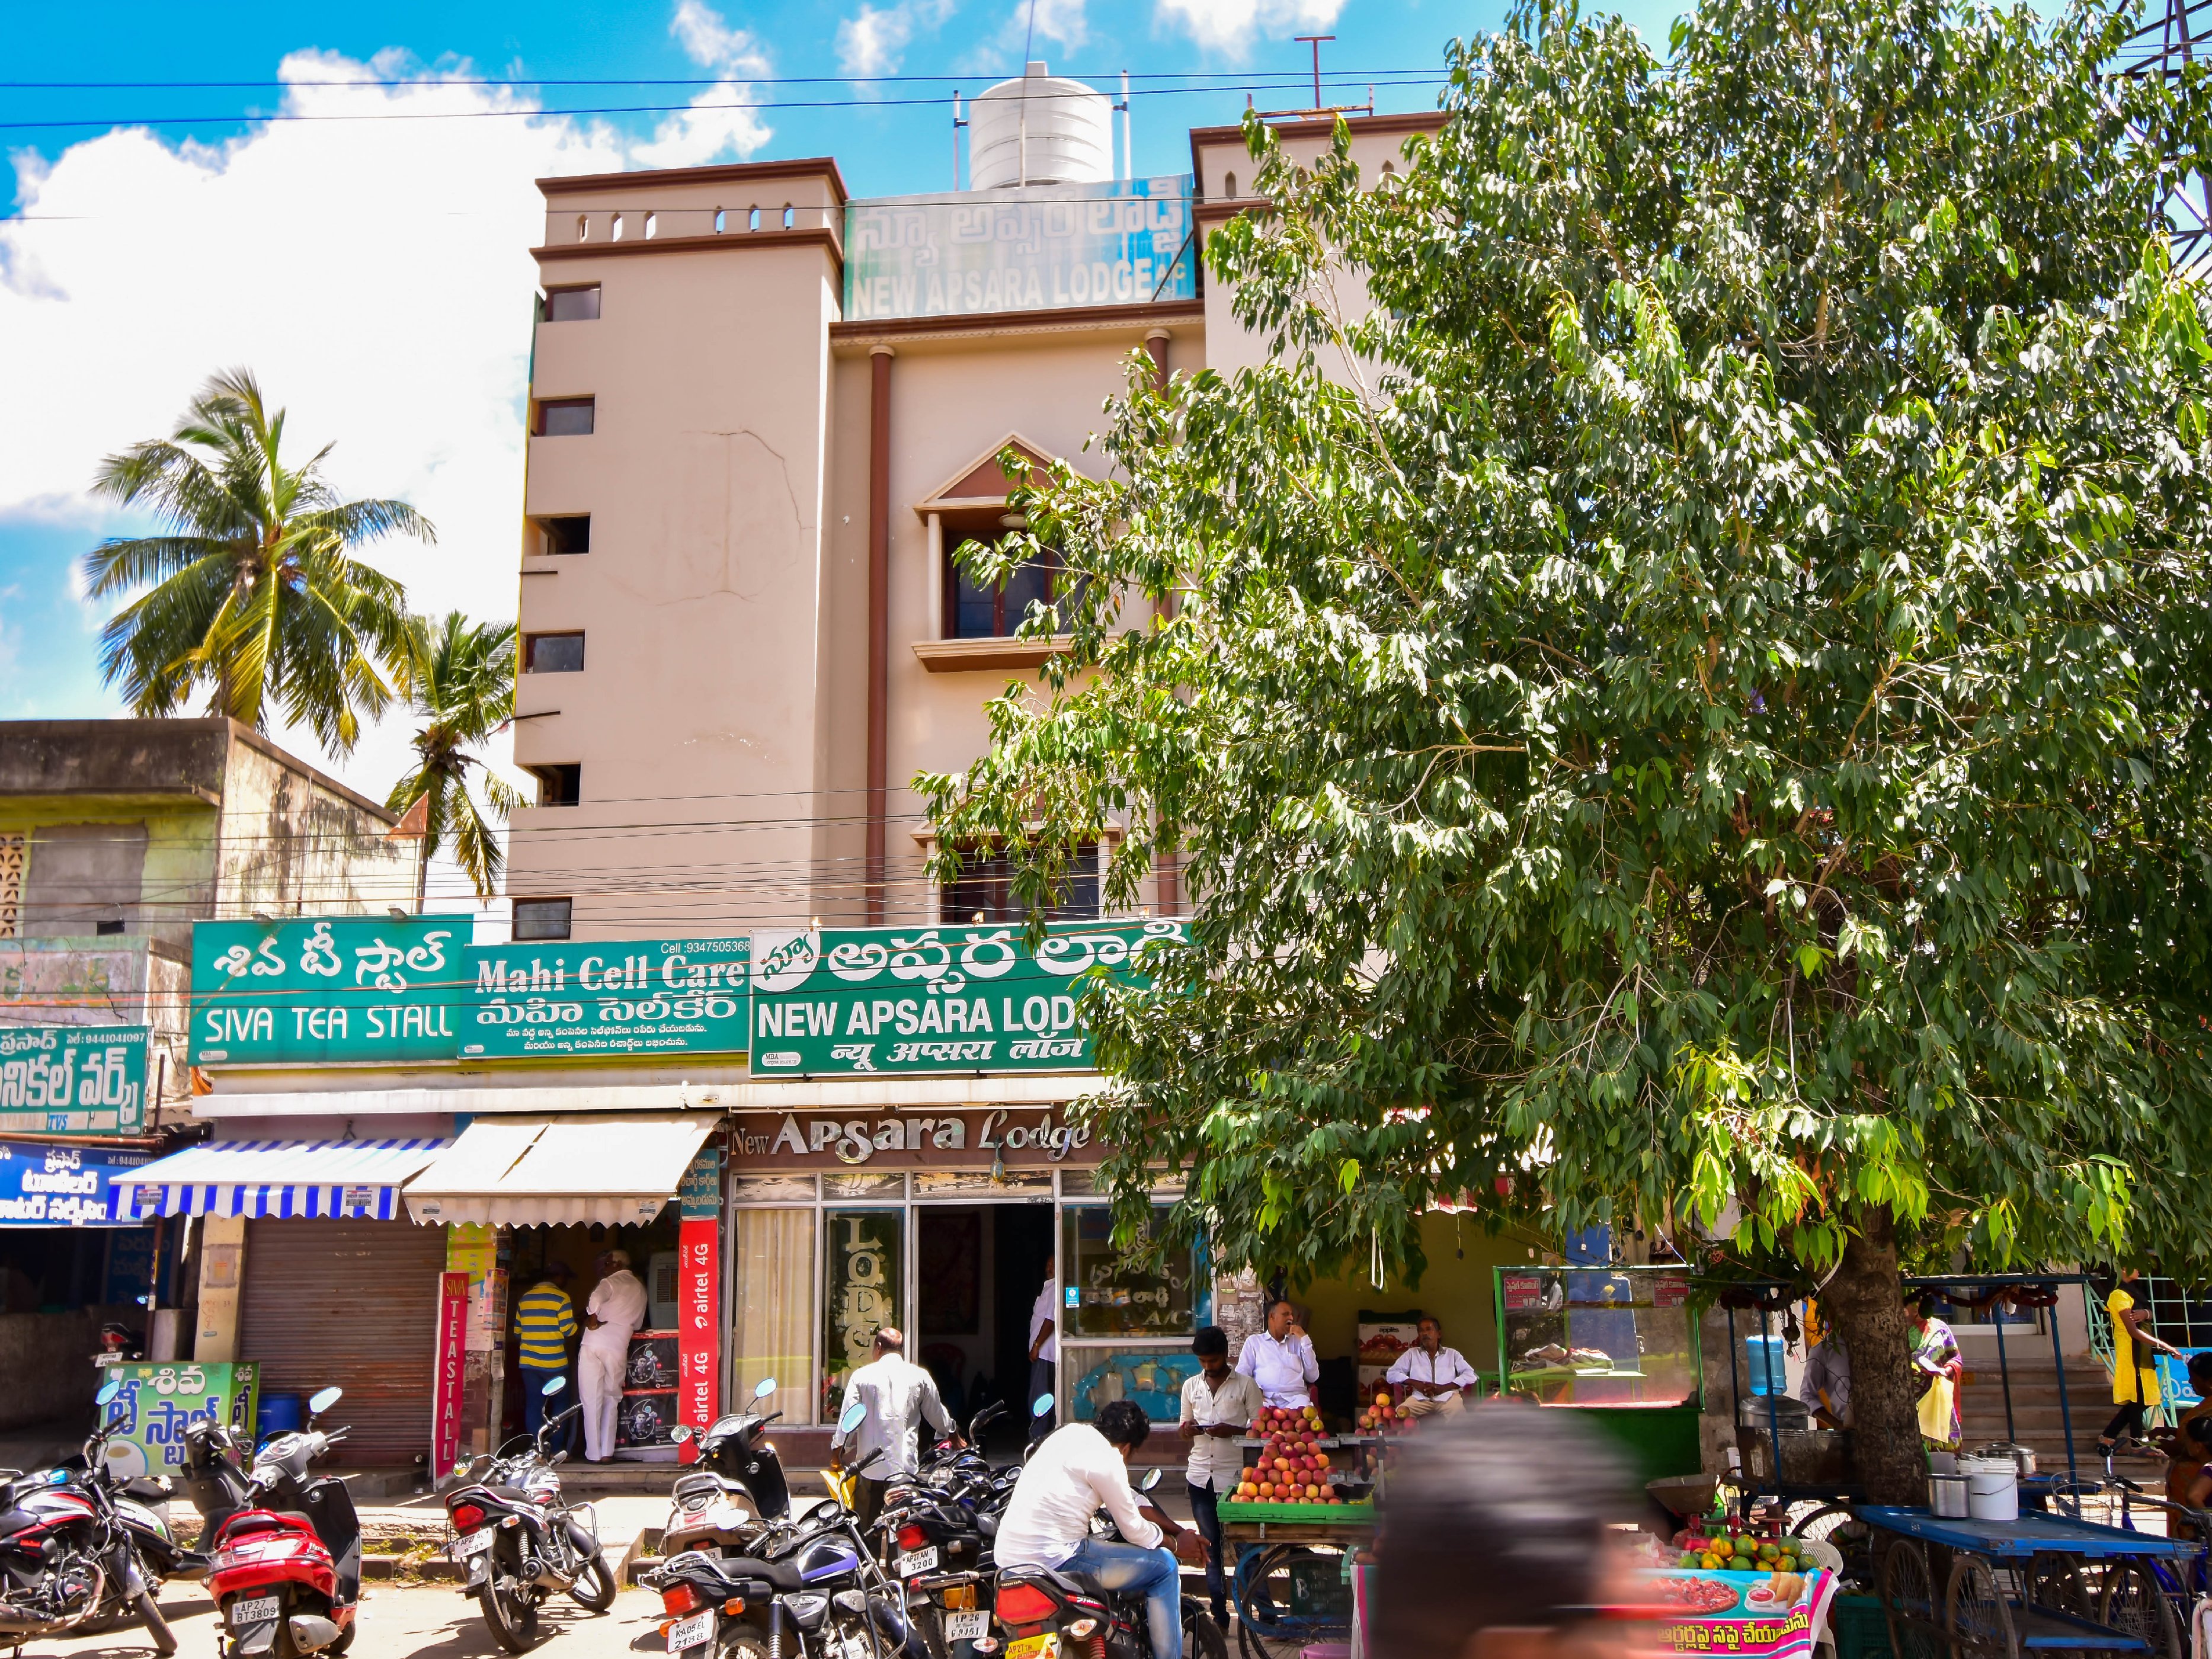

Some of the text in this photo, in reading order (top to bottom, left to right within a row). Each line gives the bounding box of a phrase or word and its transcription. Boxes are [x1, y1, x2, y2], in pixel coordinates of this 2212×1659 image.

[853, 258, 1153, 319] NEW APSARA LODGE
[213, 923, 452, 994] శివ టీ స్టాల్
[661, 943, 681, 954] Cell
[475, 955, 745, 994] Mahi Cell Care
[204, 1005, 453, 1043] SIVA TEA STALL
[476, 997, 583, 1024] మహి
[758, 995, 1093, 1038] NEW APSARA LOD
[830, 1043, 878, 1071] न्यू
[886, 1040, 997, 1064] अप्सरा
[49, 1114, 68, 1130] TVS
[731, 1128, 769, 1156] New
[978, 1109, 1090, 1162] Lodge
[446, 1279, 465, 1297] SIVA
[693, 1244, 709, 1314] airtel 4G
[148, 1366, 206, 1395] శివ
[693, 1352, 709, 1423] airtel 4G
[911, 1558, 933, 1571] 3200
[237, 1607, 276, 1622] BT3809
[241, 1599, 266, 1612] AP27
[676, 1623, 696, 1638] KA05
[1009, 1644, 1024, 1654] AP27
